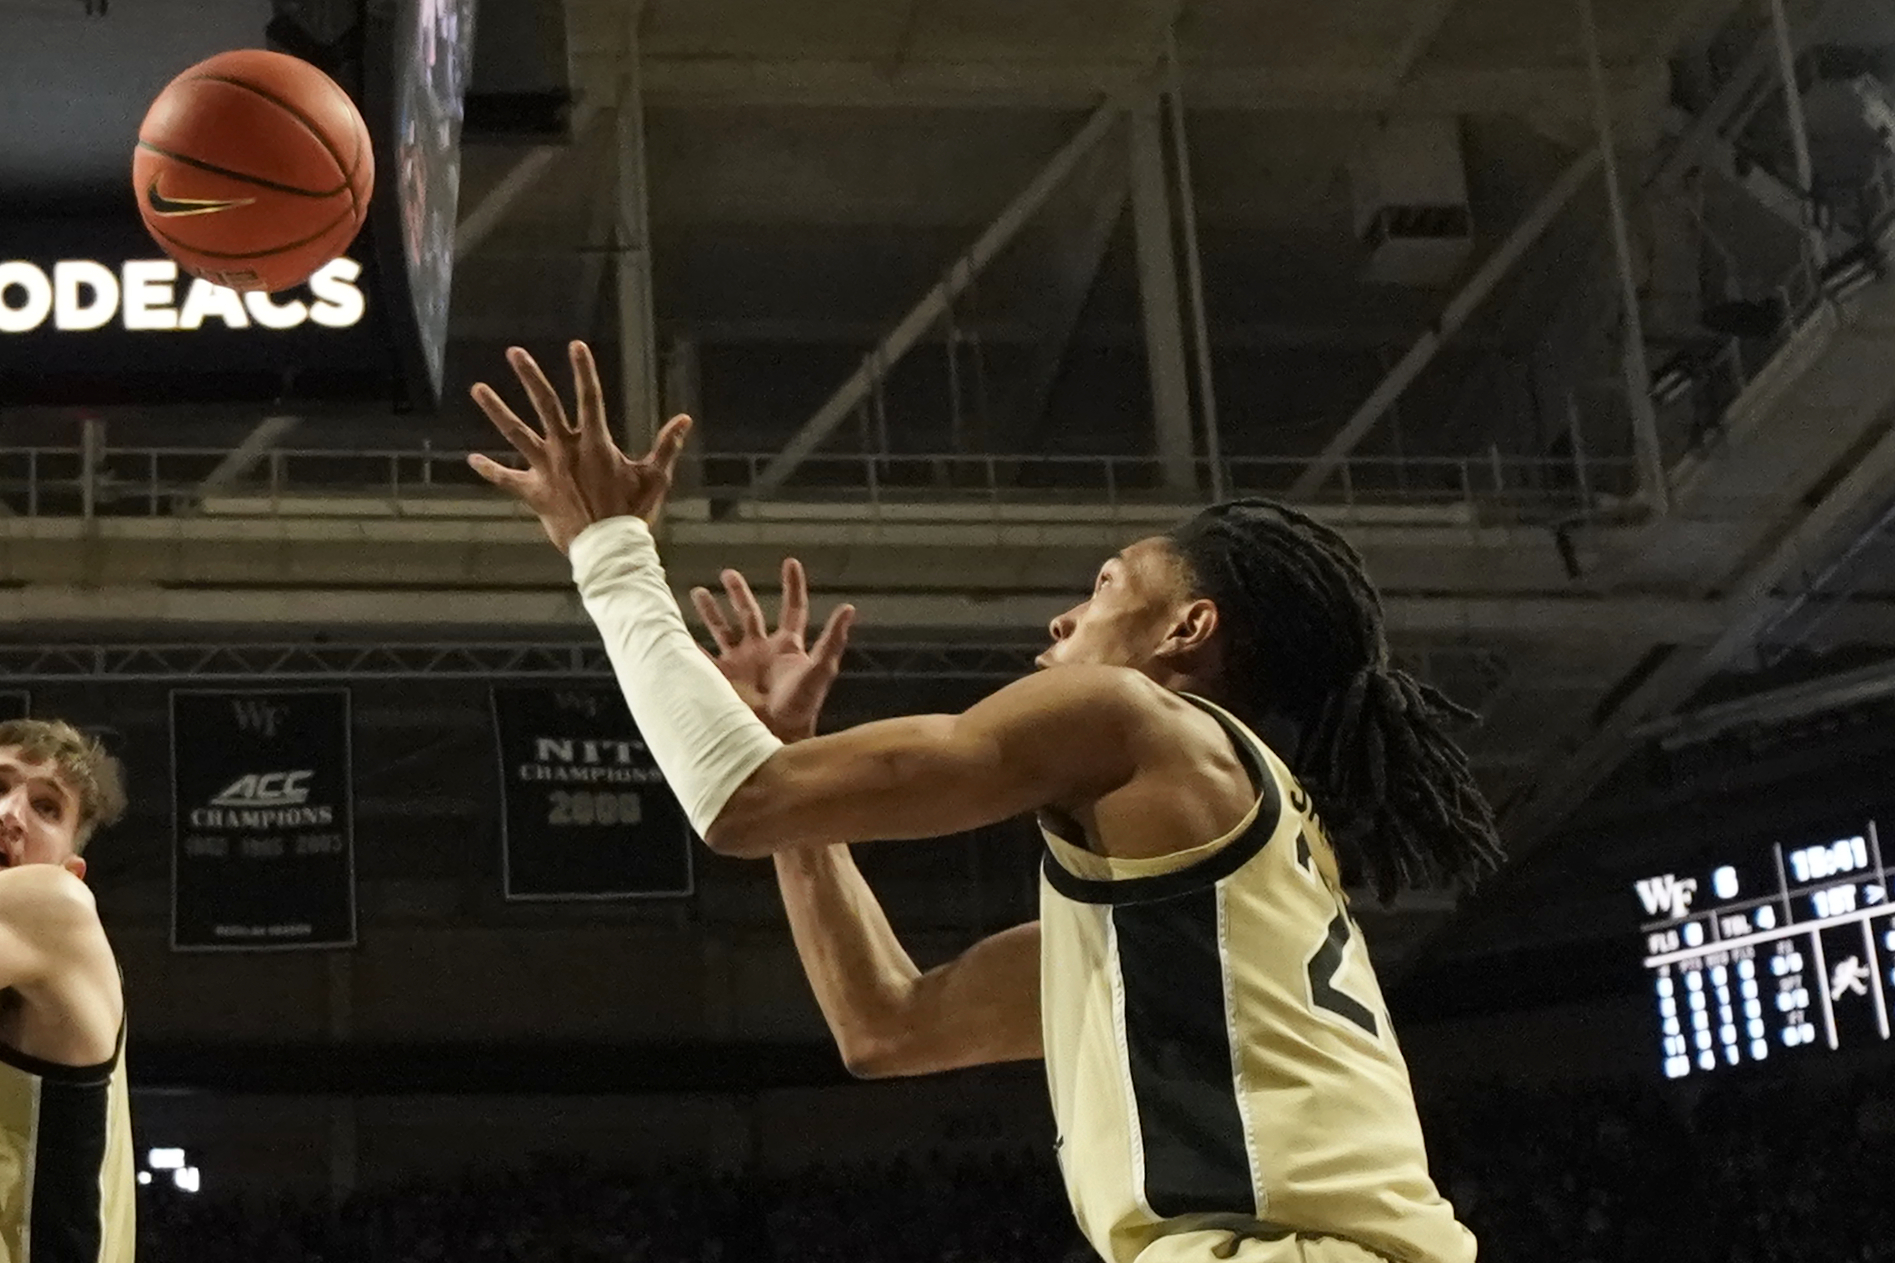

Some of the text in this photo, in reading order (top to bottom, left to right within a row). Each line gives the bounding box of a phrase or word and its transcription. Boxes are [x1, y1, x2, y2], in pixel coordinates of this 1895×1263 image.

[535, 737, 645, 764] NIT
[519, 763, 663, 784] CHAMPIONS
[210, 769, 315, 807] ACC
[190, 806, 334, 829] CHAMPIONS
[1634, 873, 1698, 919] WF
